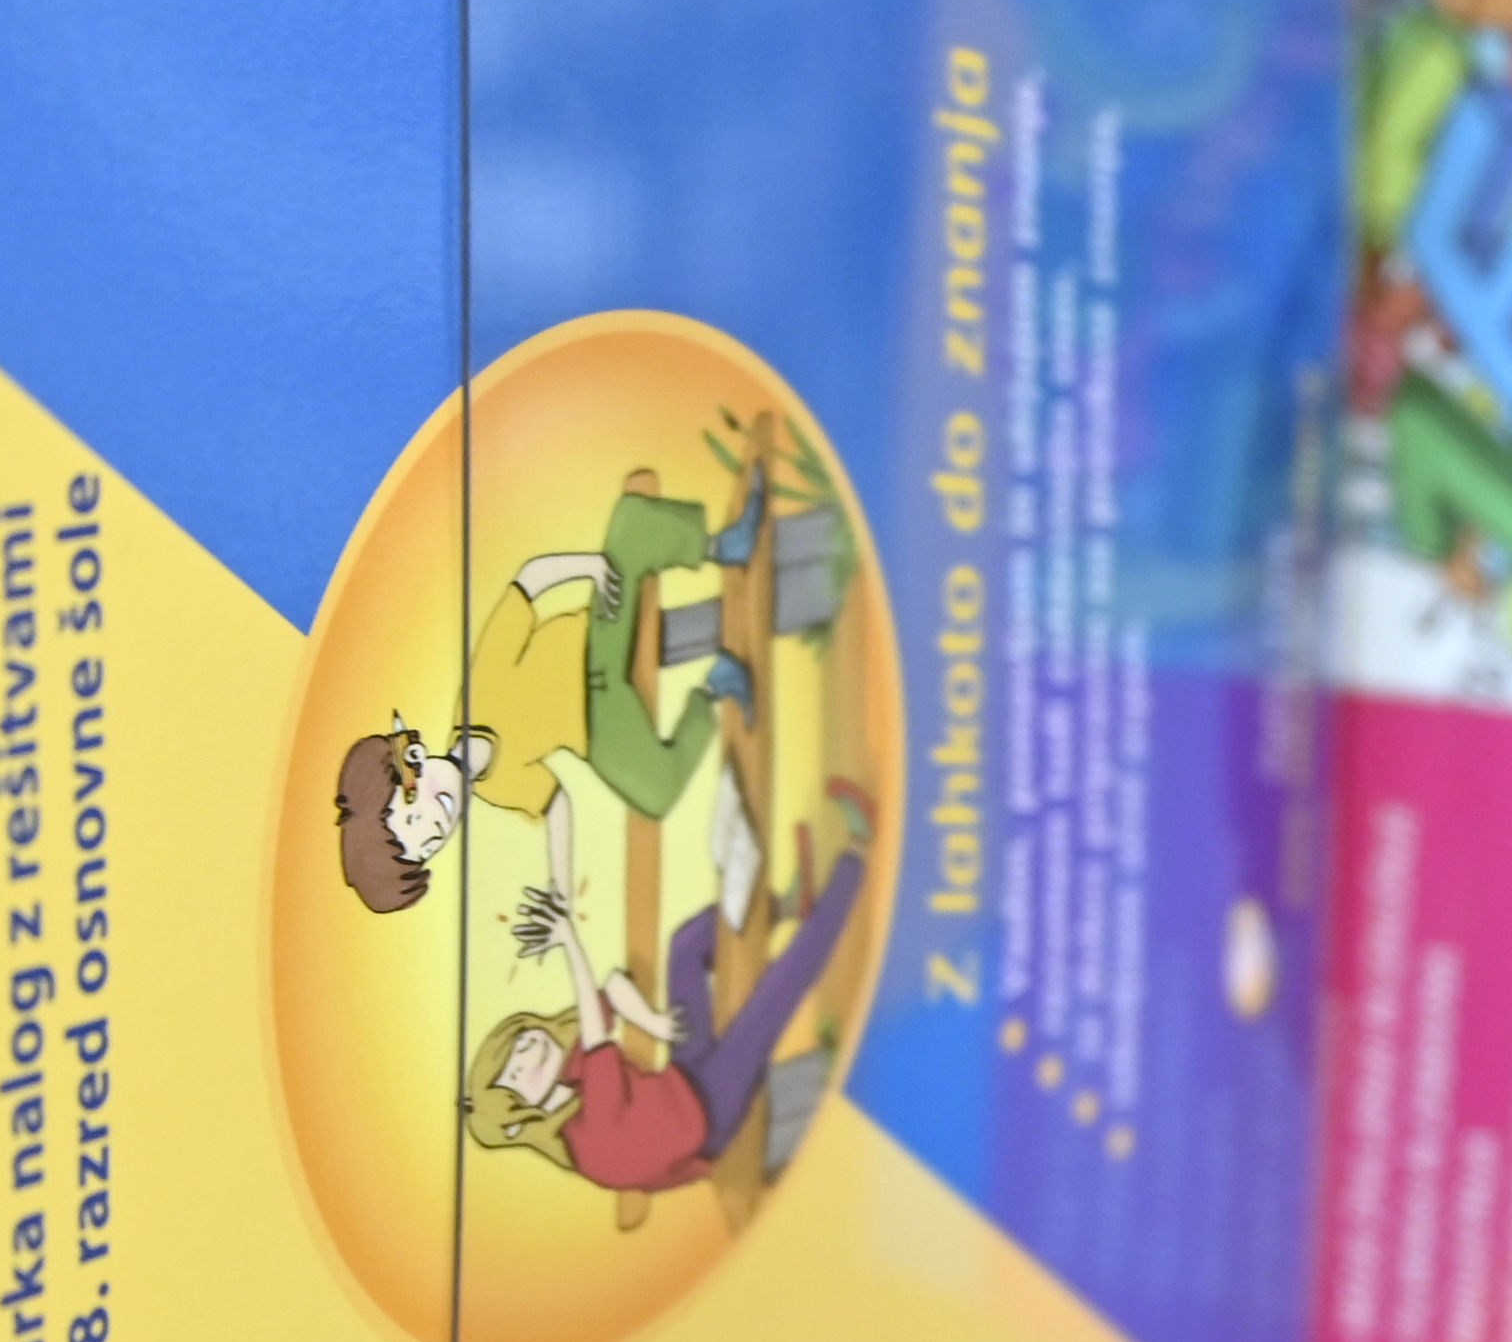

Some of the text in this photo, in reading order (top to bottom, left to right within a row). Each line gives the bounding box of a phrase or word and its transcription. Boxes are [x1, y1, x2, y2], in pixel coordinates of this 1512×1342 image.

[933, 47, 1002, 377] znanja
[55, 470, 103, 633] šole
[930, 411, 984, 532] do
[69, 657, 110, 997] osnovne
[928, 565, 984, 913] lahkoto
[9, 900, 44, 943] z
[63, 1016, 111, 1266] razred
